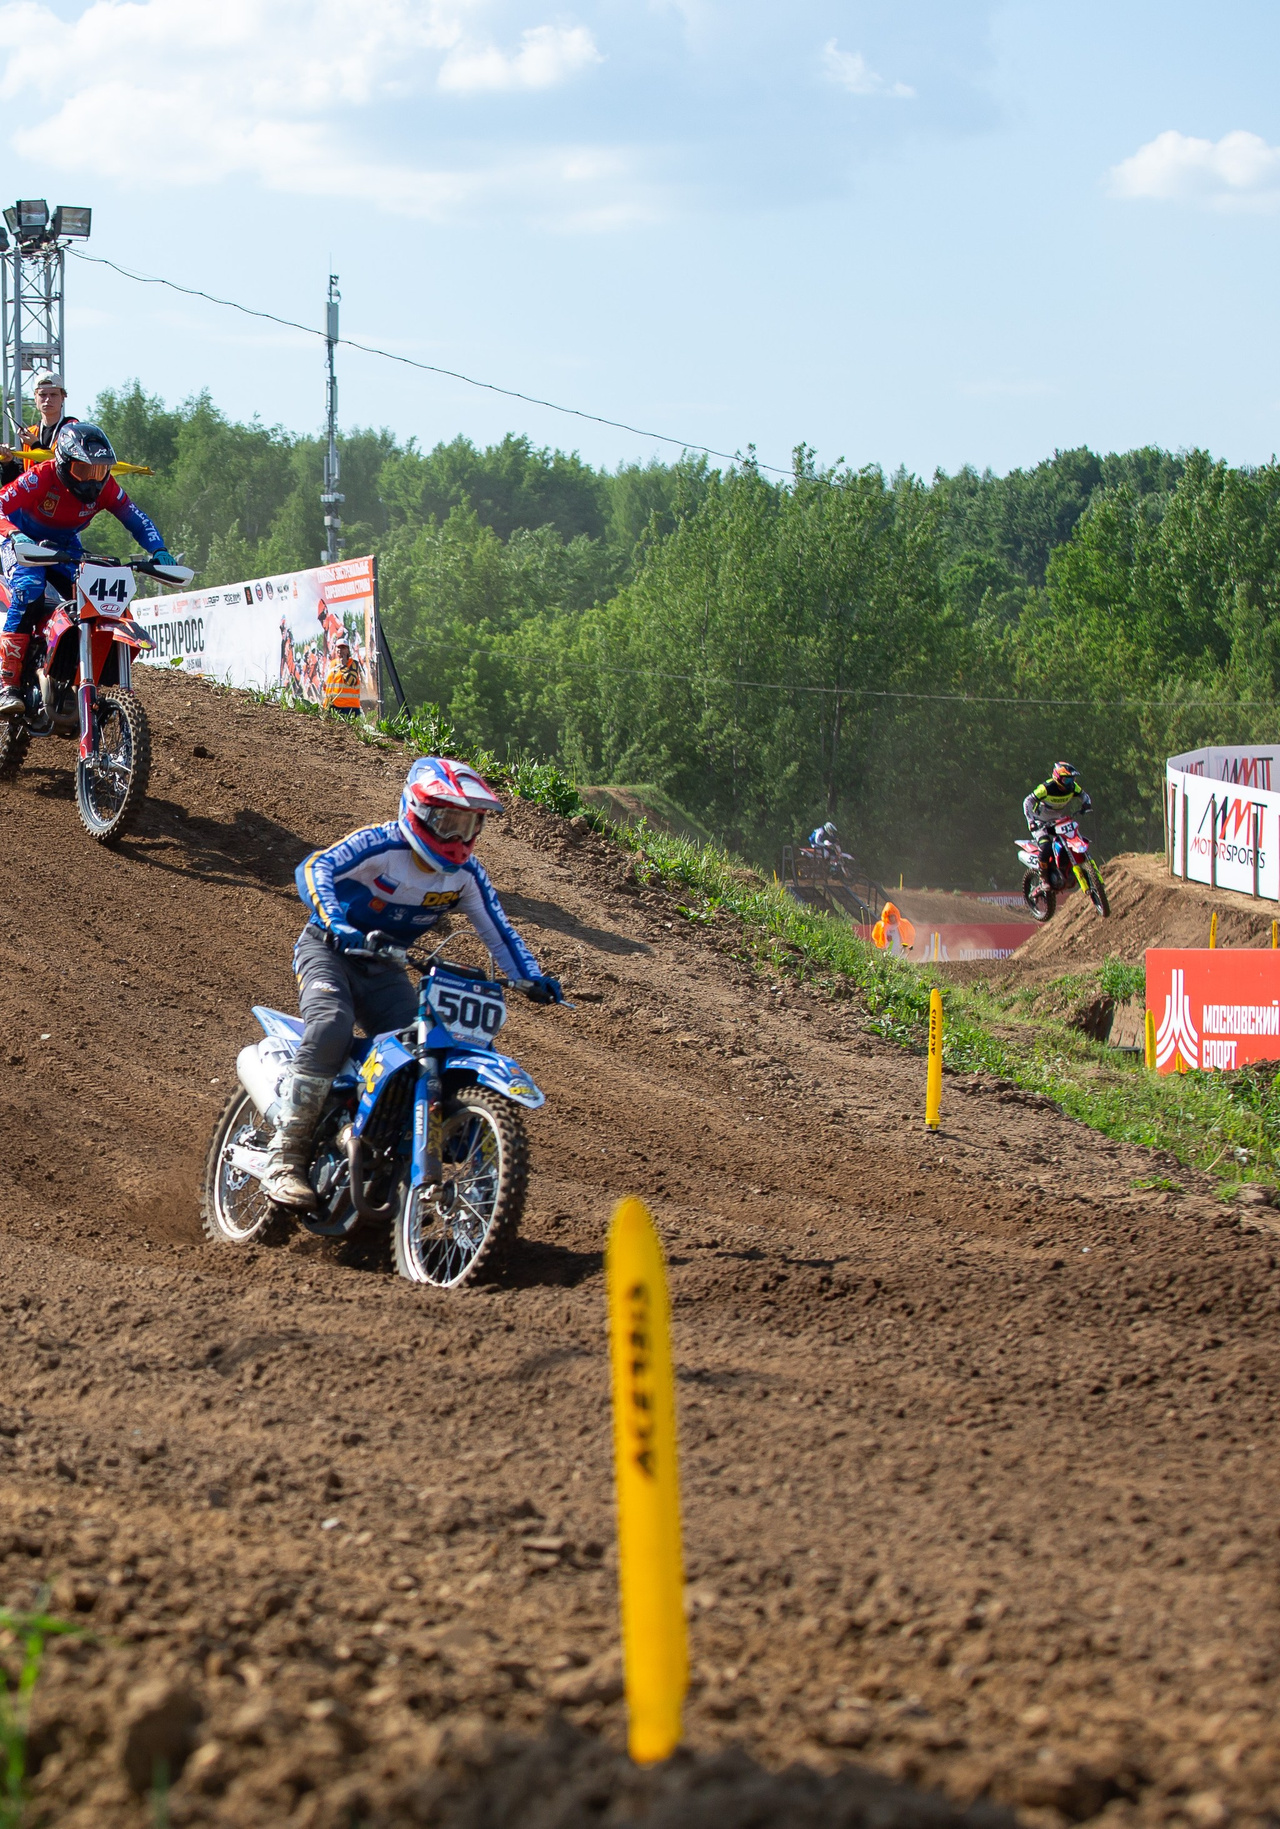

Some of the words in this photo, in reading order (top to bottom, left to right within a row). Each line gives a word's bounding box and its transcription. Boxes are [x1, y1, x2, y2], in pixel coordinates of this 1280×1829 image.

[89, 577, 128, 603] 44
[1189, 836, 1266, 869] MOTRSPORS
[438, 990, 503, 1036] 500
[1202, 1000, 1279, 1036] МОСКОВСКИЙ
[1202, 1040, 1238, 1070] СПОРТ
[415, 1104, 424, 1135] TEAM
